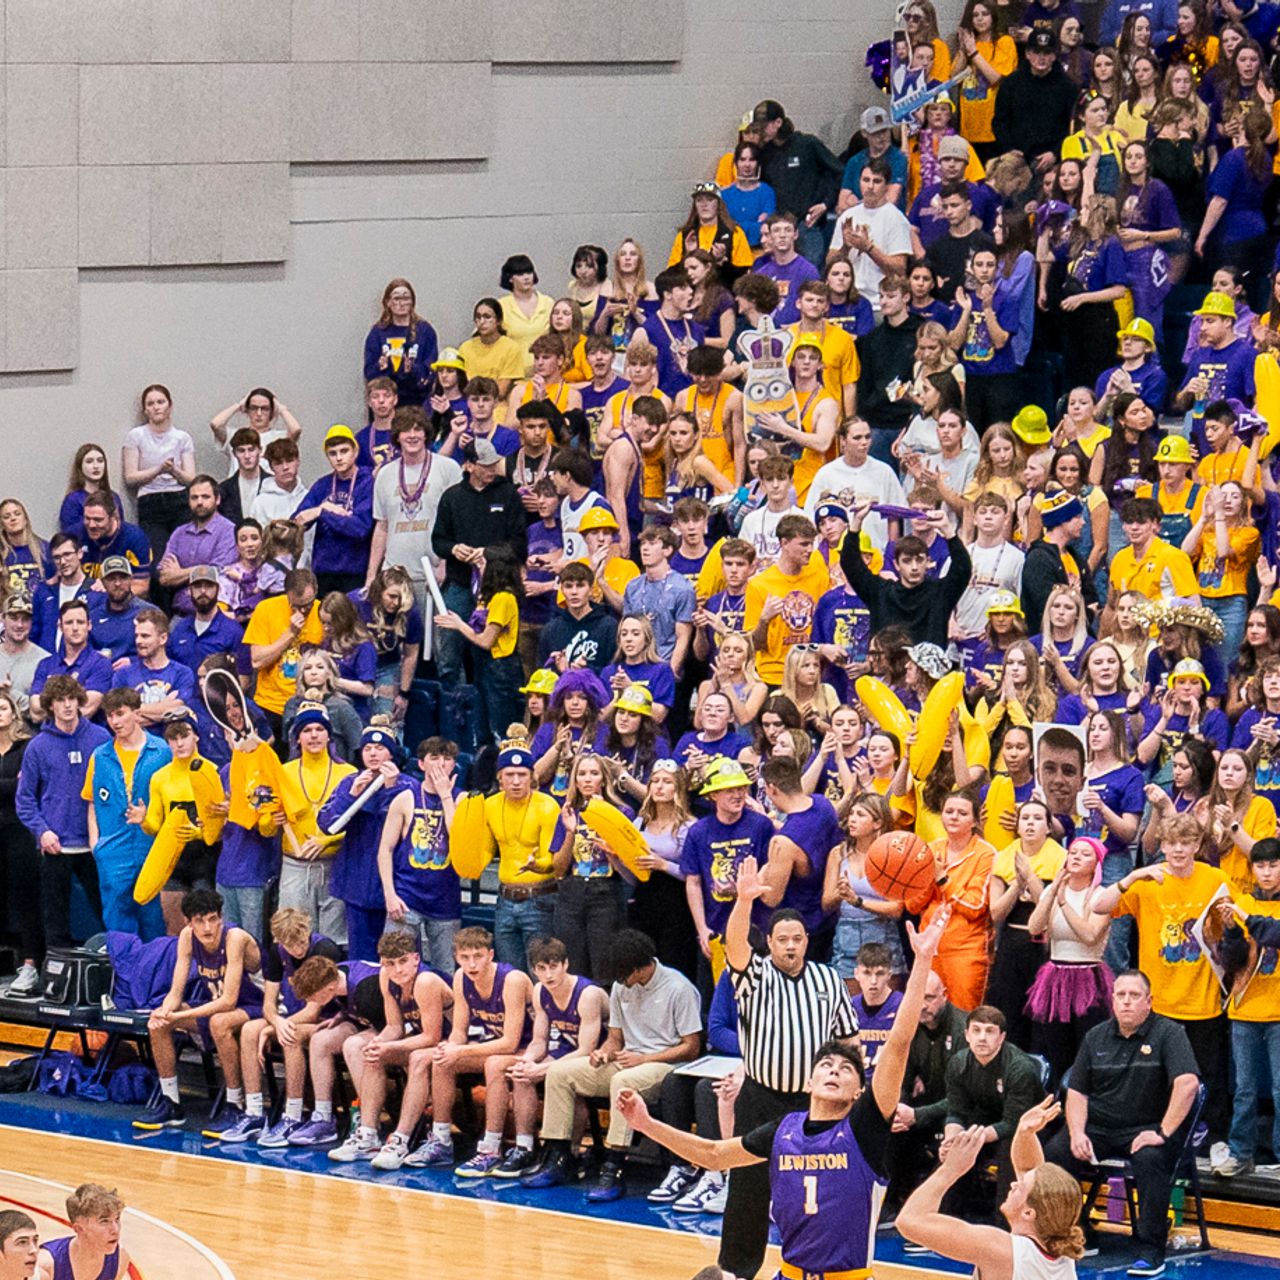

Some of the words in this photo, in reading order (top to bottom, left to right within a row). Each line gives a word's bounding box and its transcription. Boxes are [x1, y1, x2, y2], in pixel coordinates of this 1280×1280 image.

[565, 538, 575, 557] 3
[778, 1152, 848, 1171] LEWISTON
[802, 1175, 820, 1215] 1
